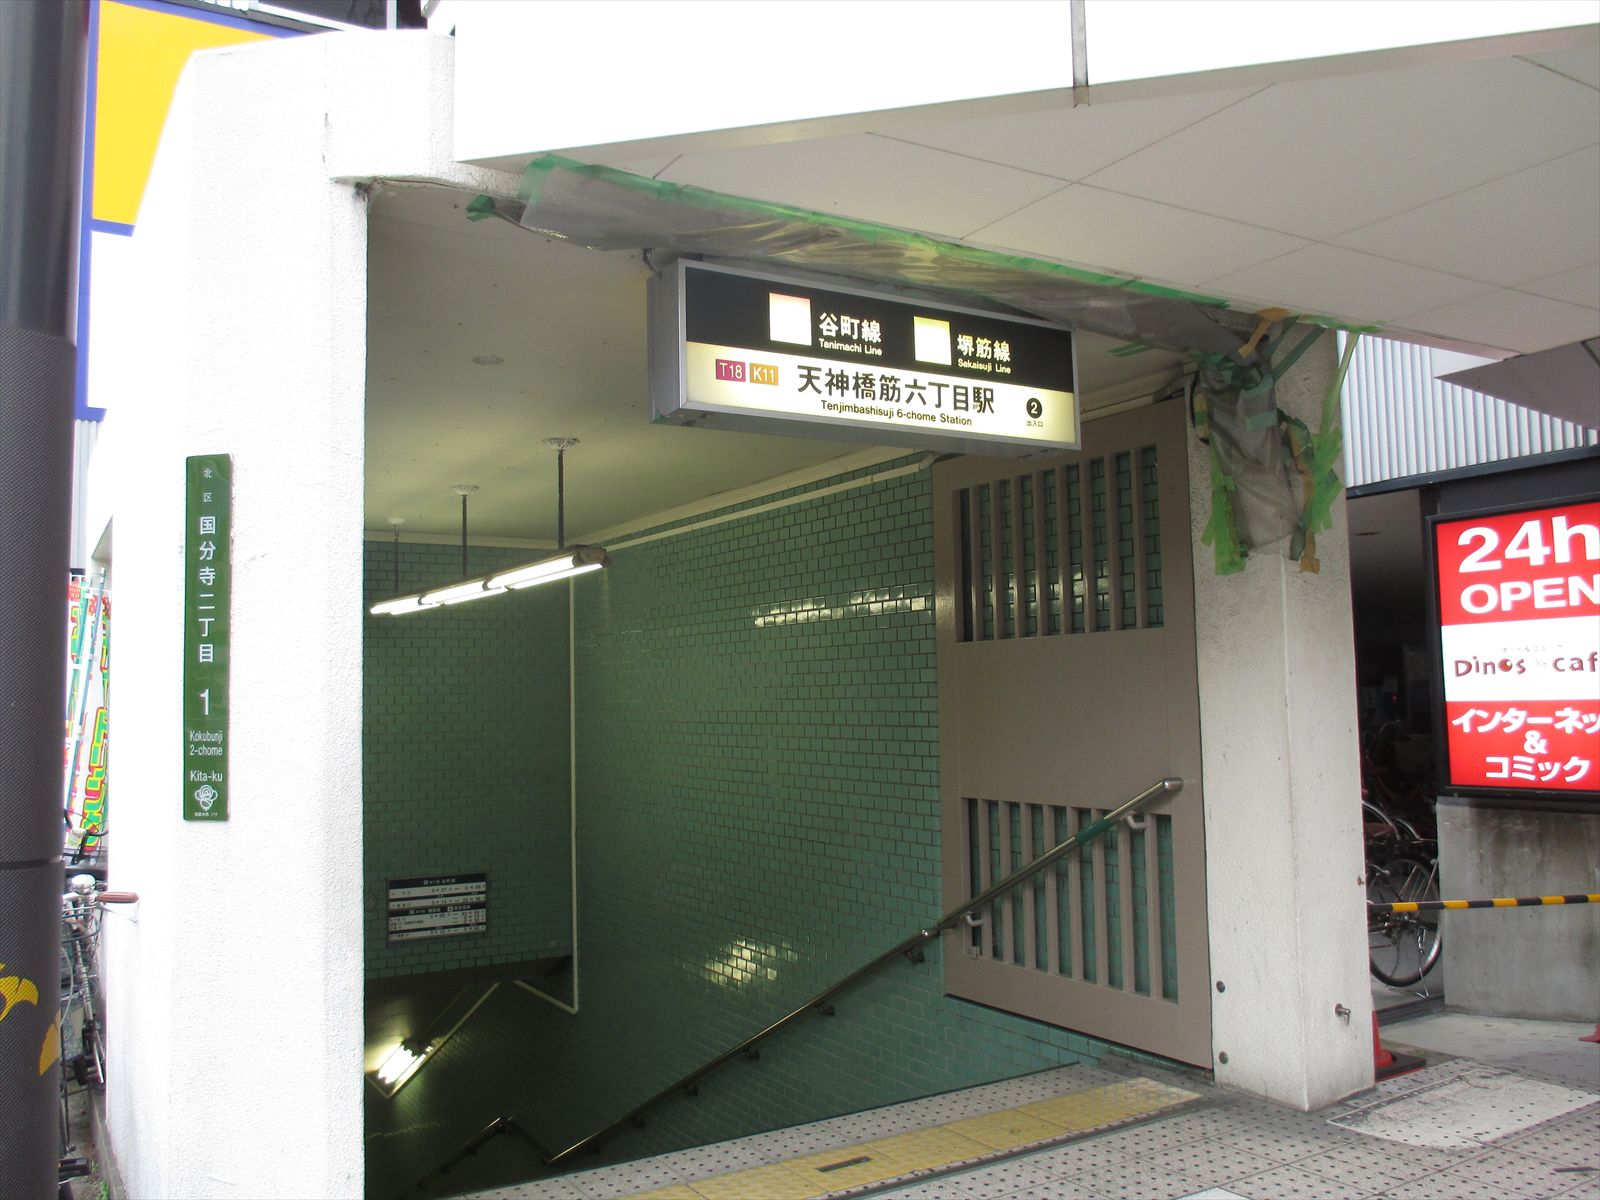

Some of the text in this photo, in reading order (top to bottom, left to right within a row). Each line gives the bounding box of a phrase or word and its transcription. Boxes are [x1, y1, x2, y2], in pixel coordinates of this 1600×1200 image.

[818, 312, 882, 344] 谷町線
[818, 338, 883, 356] Tanimachi Line
[956, 333, 1011, 363] 堺筋線
[719, 362, 775, 382] T18 K11
[957, 358, 1012, 375] Sakaisuji Line
[796, 364, 995, 415] 天神橋筋六丁目駅
[821, 399, 973, 427] Tenjimbashisuji 6-chome Station
[1030, 401, 1039, 414] 2
[1026, 420, 1044, 428] 出入口
[1457, 515, 1600, 574] 24h
[198, 467, 217, 716] 北区 国分寺二丁目 1
[1460, 573, 1600, 615] OPEN
[1454, 655, 1526, 678] Dinos
[1451, 706, 1600, 734] インターネッ
[189, 730, 223, 744] Kokubunji
[1523, 730, 1548, 754] &
[189, 744, 223, 756] 2-chome
[190, 769, 223, 782] Kita-ku
[1485, 755, 1591, 783] コミック
